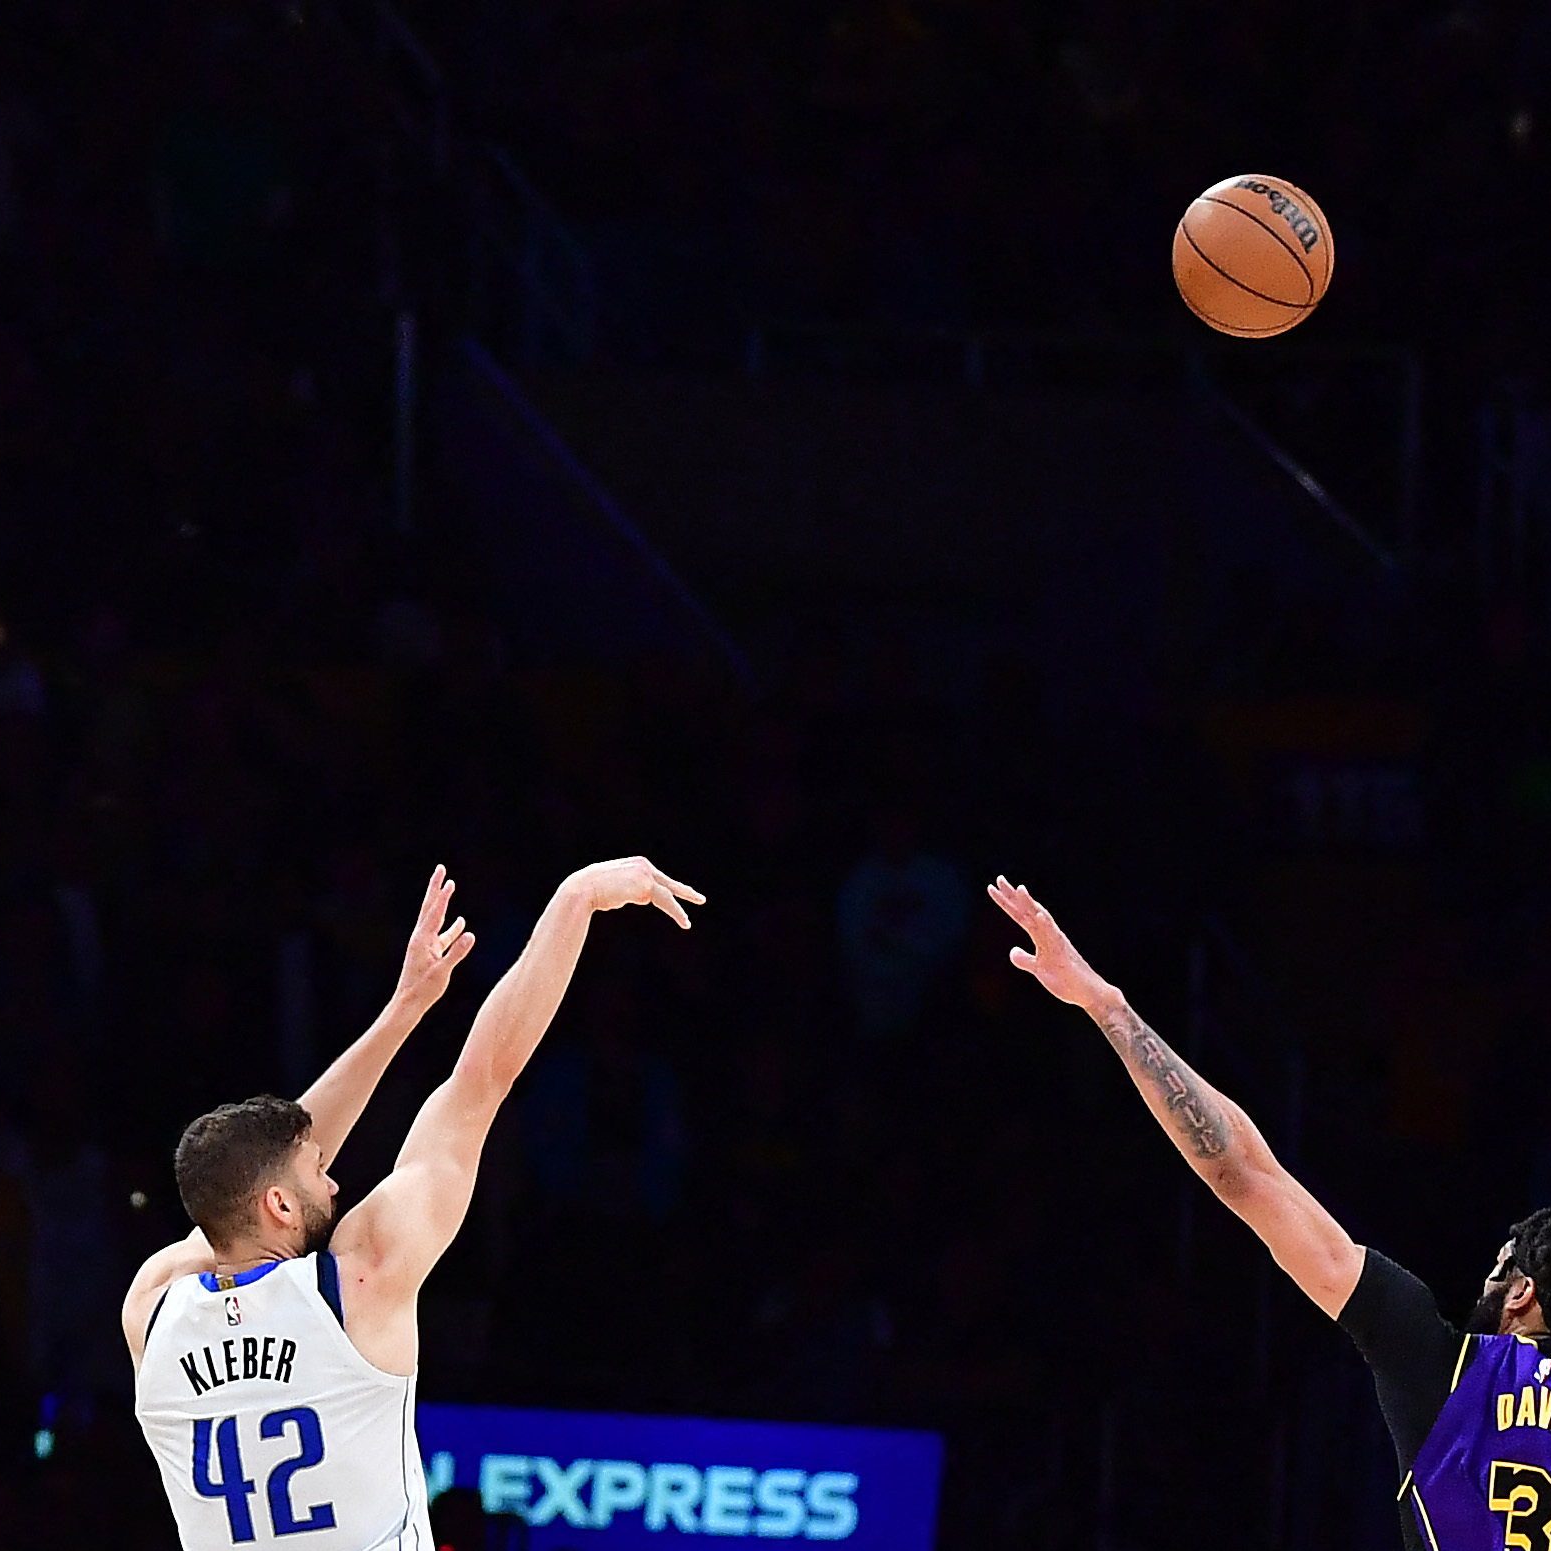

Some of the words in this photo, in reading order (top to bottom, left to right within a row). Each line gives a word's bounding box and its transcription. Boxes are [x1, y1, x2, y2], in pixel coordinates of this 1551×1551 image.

[179, 1337, 296, 1396] KLEBER
[192, 1407, 337, 1545] 42
[480, 1453, 861, 1541] EXPRESS
